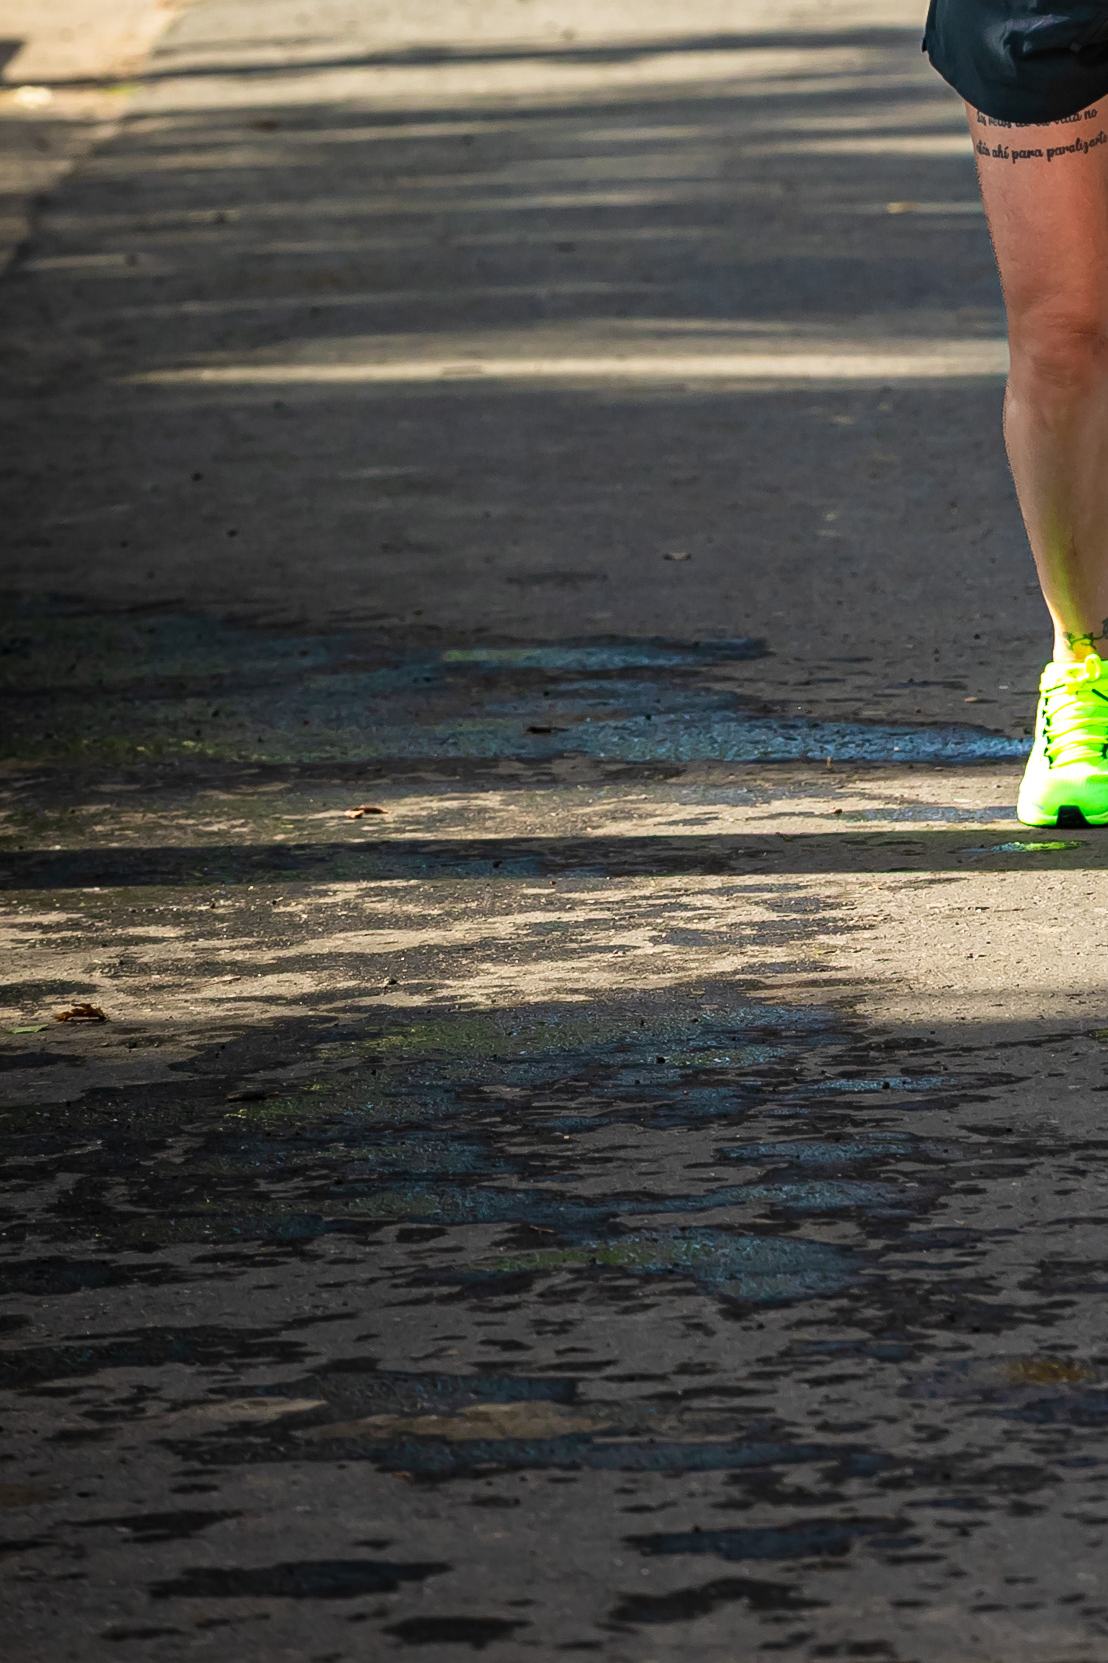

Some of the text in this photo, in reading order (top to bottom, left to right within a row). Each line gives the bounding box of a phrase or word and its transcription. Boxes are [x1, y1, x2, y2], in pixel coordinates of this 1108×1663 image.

[1084, 108, 1098, 120] no
[992, 144, 1010, 159] ahí
[1011, 148, 1043, 164] para
[1046, 130, 1108, 162] paralizarte
